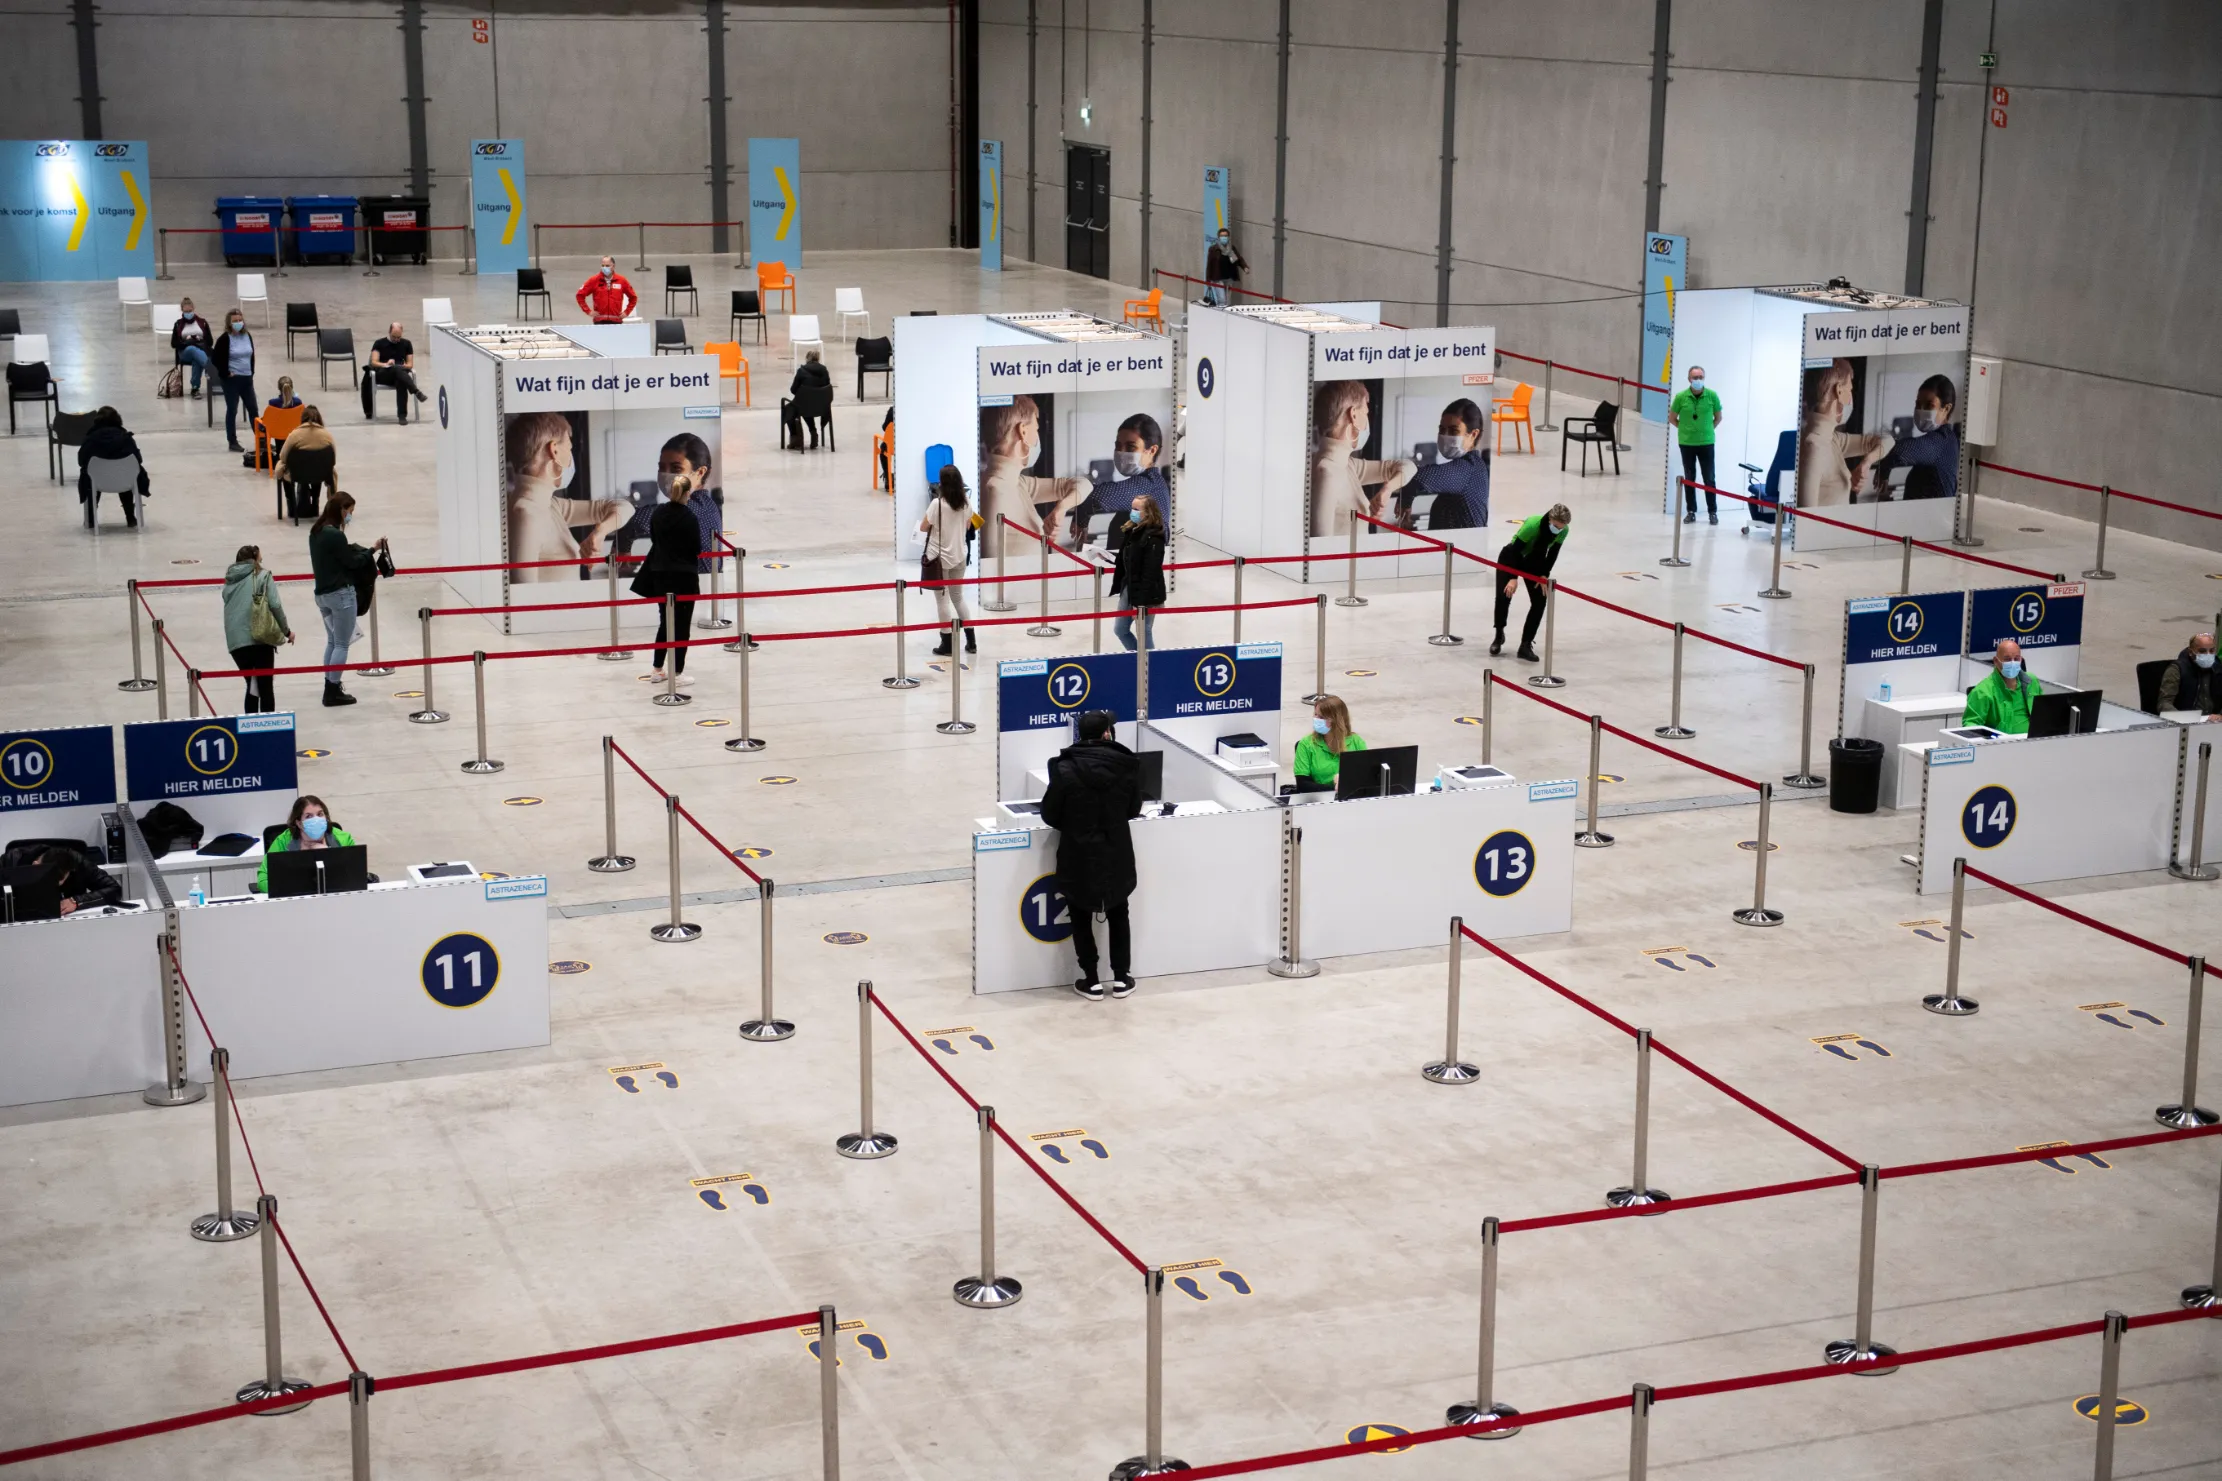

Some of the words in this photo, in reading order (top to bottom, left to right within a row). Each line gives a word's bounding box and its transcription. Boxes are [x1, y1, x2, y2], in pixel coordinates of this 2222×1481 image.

[95, 144, 128, 156] GGD
[475, 143, 507, 155] GGD
[477, 203, 512, 213] Uitgang
[752, 199, 786, 210] Uitgang
[35, 207, 44, 218] je
[47, 207, 77, 216] komst
[98, 207, 136, 217] Uitgang
[1815, 327, 1841, 341] Wat
[1845, 326, 1867, 342] fijn
[1871, 324, 1893, 339] dat
[1895, 324, 1909, 340] je
[1912, 325, 1927, 336] er
[1930, 321, 1961, 335] bent
[1325, 348, 1354, 362] Wat
[1359, 346, 1383, 364] fijn
[1387, 346, 1411, 360] dat
[1414, 344, 1429, 362] je
[1433, 346, 1449, 358] er
[1453, 342, 1487, 357] bent
[990, 361, 1022, 376] Wat
[1026, 360, 1052, 378] fijn
[1057, 359, 1082, 374] dat
[1086, 358, 1101, 376] je
[1106, 360, 1123, 372] er
[1127, 355, 1163, 370] bent
[516, 376, 551, 393] Wat
[556, 376, 586, 395] fijn
[591, 374, 620, 391] dat
[624, 374, 641, 394] je
[646, 376, 665, 389] er
[670, 372, 710, 388] bent
[1202, 367, 1210, 388] 9
[1467, 375, 1489, 383] PFIZER
[2053, 585, 2079, 595] PFIZER
[1852, 601, 1887, 610] ASTRAZENECA
[2016, 602, 2039, 622] 15
[1894, 612, 1918, 632] 14
[2017, 633, 2058, 646] MELDEN
[1239, 648, 1279, 658] ASTRAZENECA
[1871, 647, 1894, 659] HIER
[1896, 643, 1938, 657] MELDEN
[1003, 664, 1047, 674] ASTRAZENECA
[1201, 664, 1229, 686] 13
[1055, 675, 1083, 697] 12
[1176, 702, 1203, 714] HIER
[1206, 698, 1253, 712] MELDEN
[241, 719, 291, 729] ASTRAZENECA
[1029, 713, 1057, 725] HIER
[195, 738, 226, 762] 11
[1933, 751, 1972, 761] ASTRAZENECA
[8, 751, 44, 776] 10
[165, 780, 199, 794] HIER
[202, 776, 262, 792] MELDEN
[1533, 786, 1574, 797] ASTRAZENECA
[17, 790, 79, 806] MELDEN
[1971, 800, 2009, 834] 14
[980, 836, 1027, 846] ASTRAZENECA
[1484, 846, 1527, 882] 13
[490, 883, 543, 895] ASTRAZENECA
[1031, 892, 1071, 926] 12
[434, 950, 482, 990] 11
[694, 1178, 725, 1186] WACHT
[1165, 1263, 1196, 1272] WACHT
[1198, 1260, 1220, 1268] HIER
[838, 1321, 862, 1330] HIER
